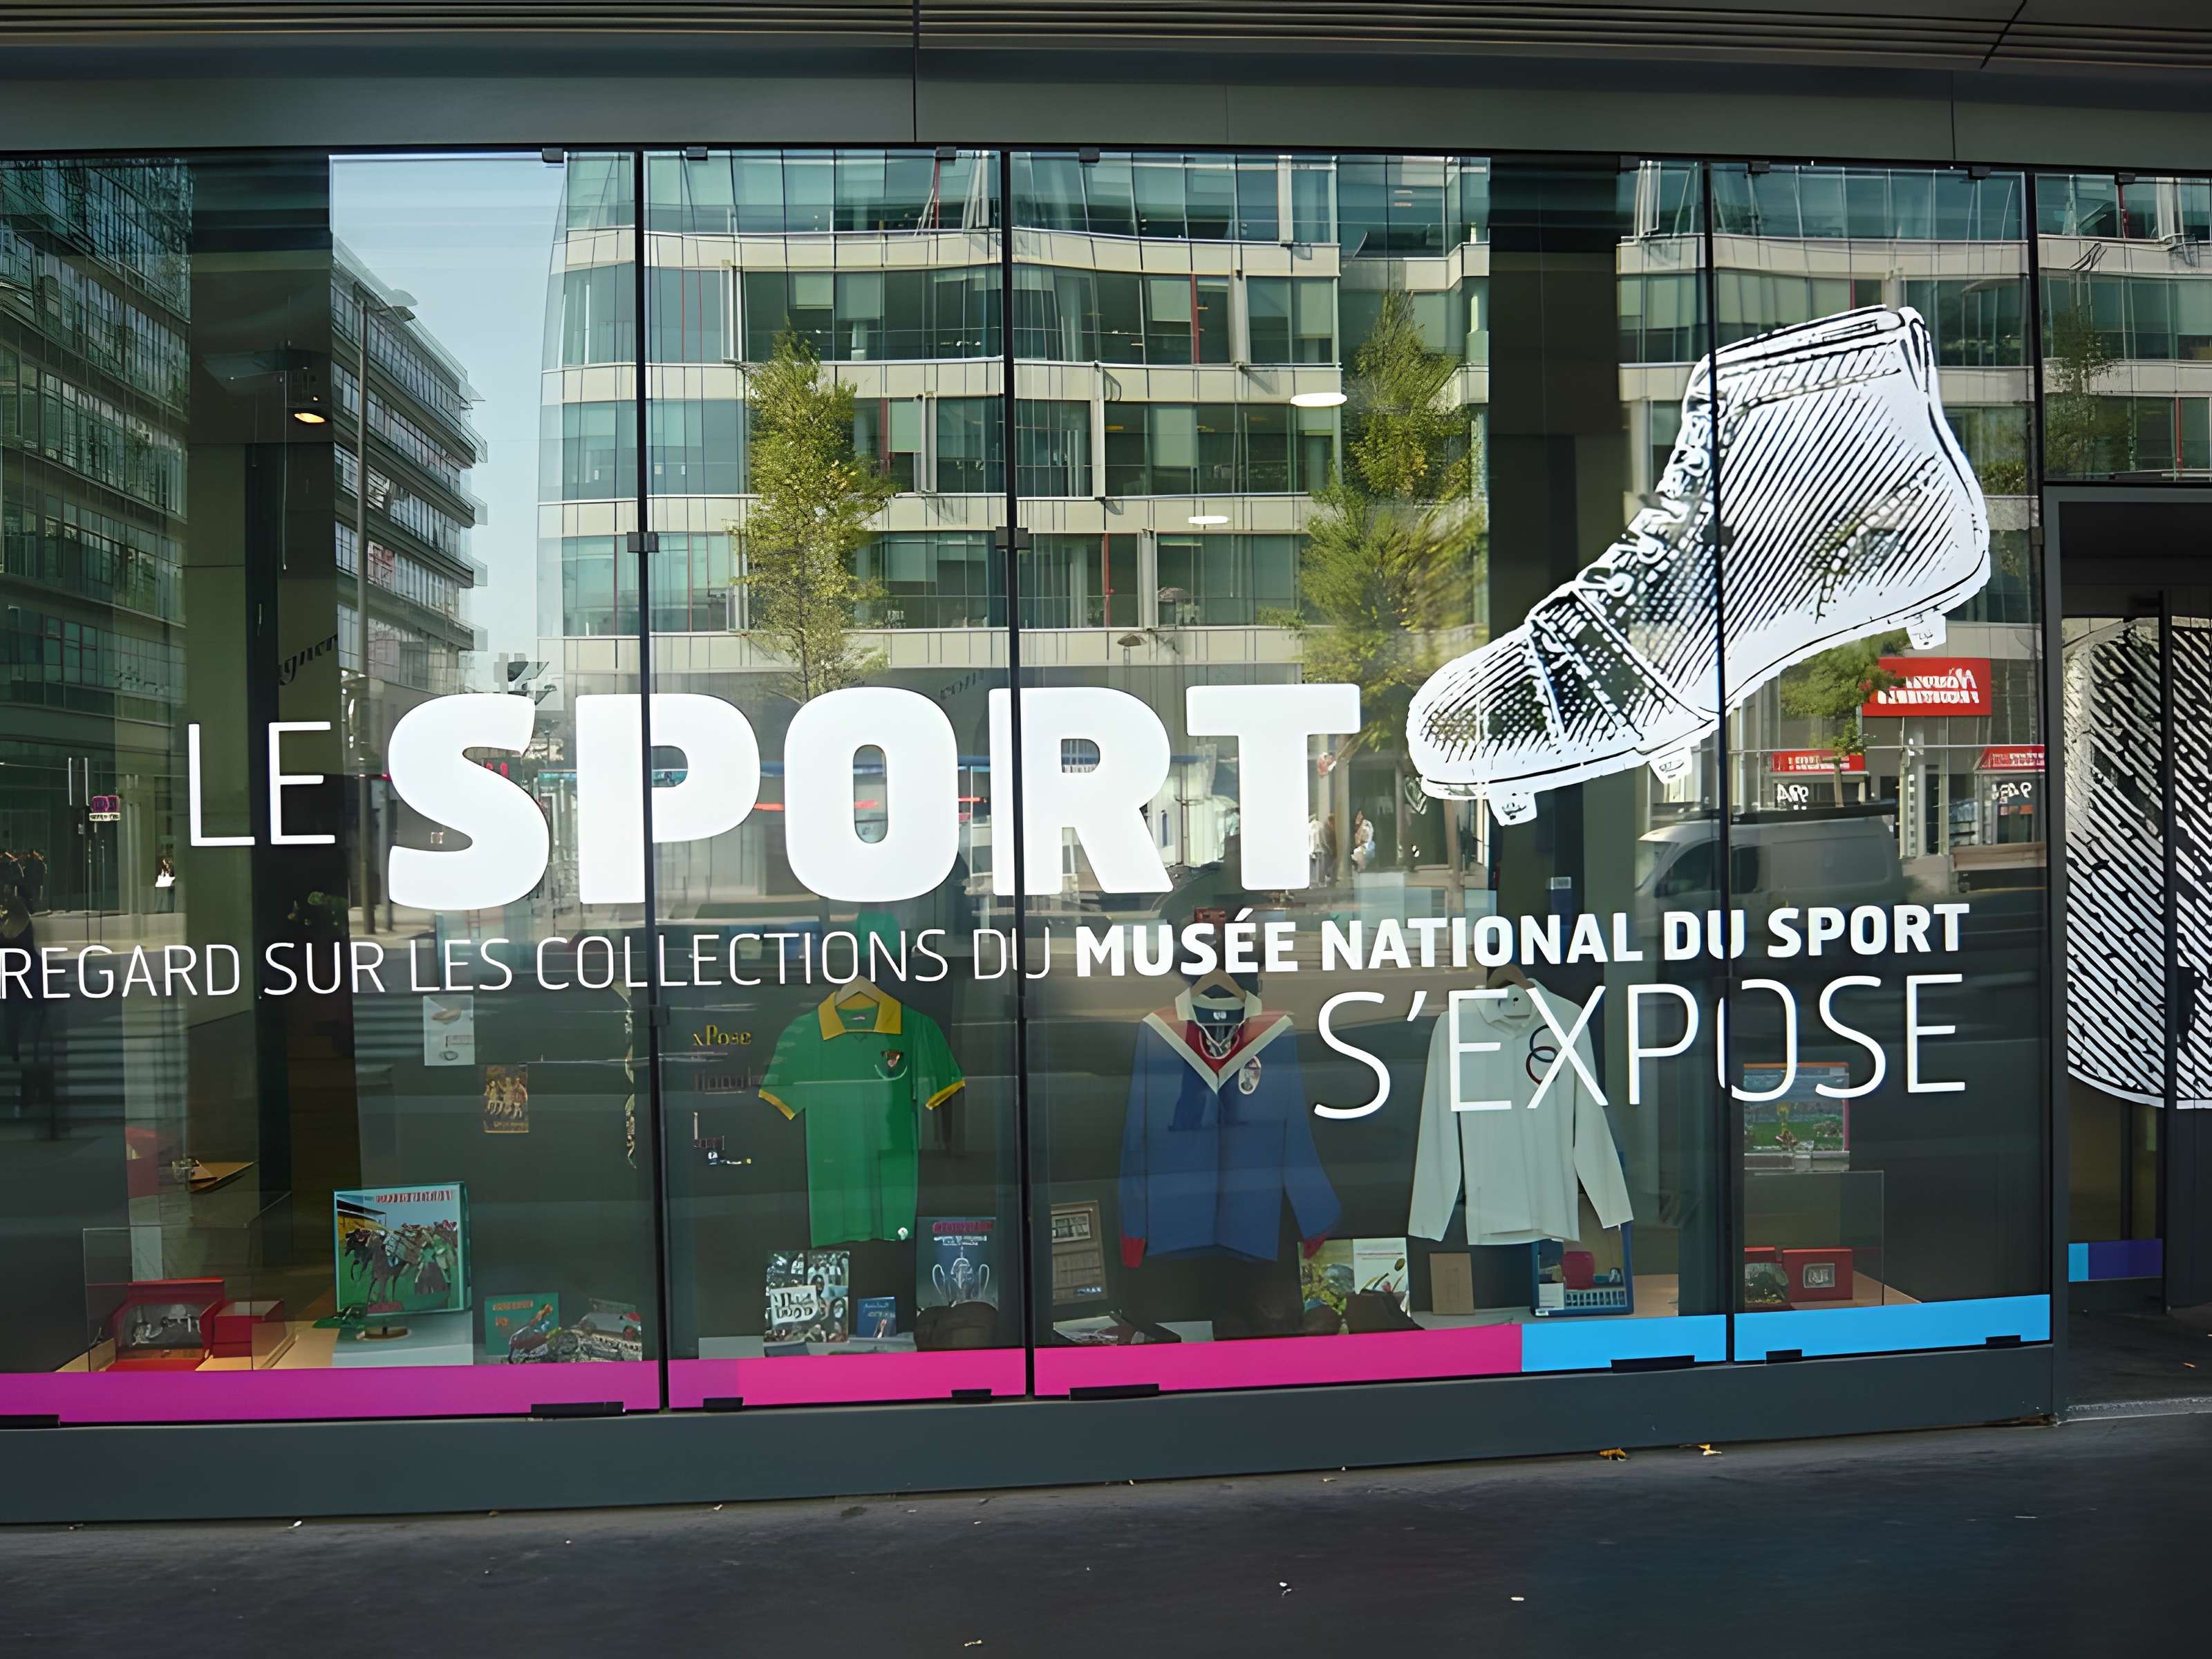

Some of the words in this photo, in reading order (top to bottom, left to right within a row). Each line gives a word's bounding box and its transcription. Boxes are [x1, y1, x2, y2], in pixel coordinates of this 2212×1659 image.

[188, 722, 336, 847] LE
[388, 683, 1362, 911] SPORT
[0, 944, 241, 1000] REGARD
[263, 941, 386, 995] SUR
[410, 937, 512, 991] LES
[536, 929, 949, 990] COLLECTIONS
[973, 927, 1051, 980] DU
[1076, 908, 1299, 977] MUSÉE
[1321, 912, 1644, 971] NATIONAL
[1664, 909, 1745, 961] DU
[1768, 903, 1970, 958] SPORT
[1314, 973, 1966, 1119] S'EXPOSE
